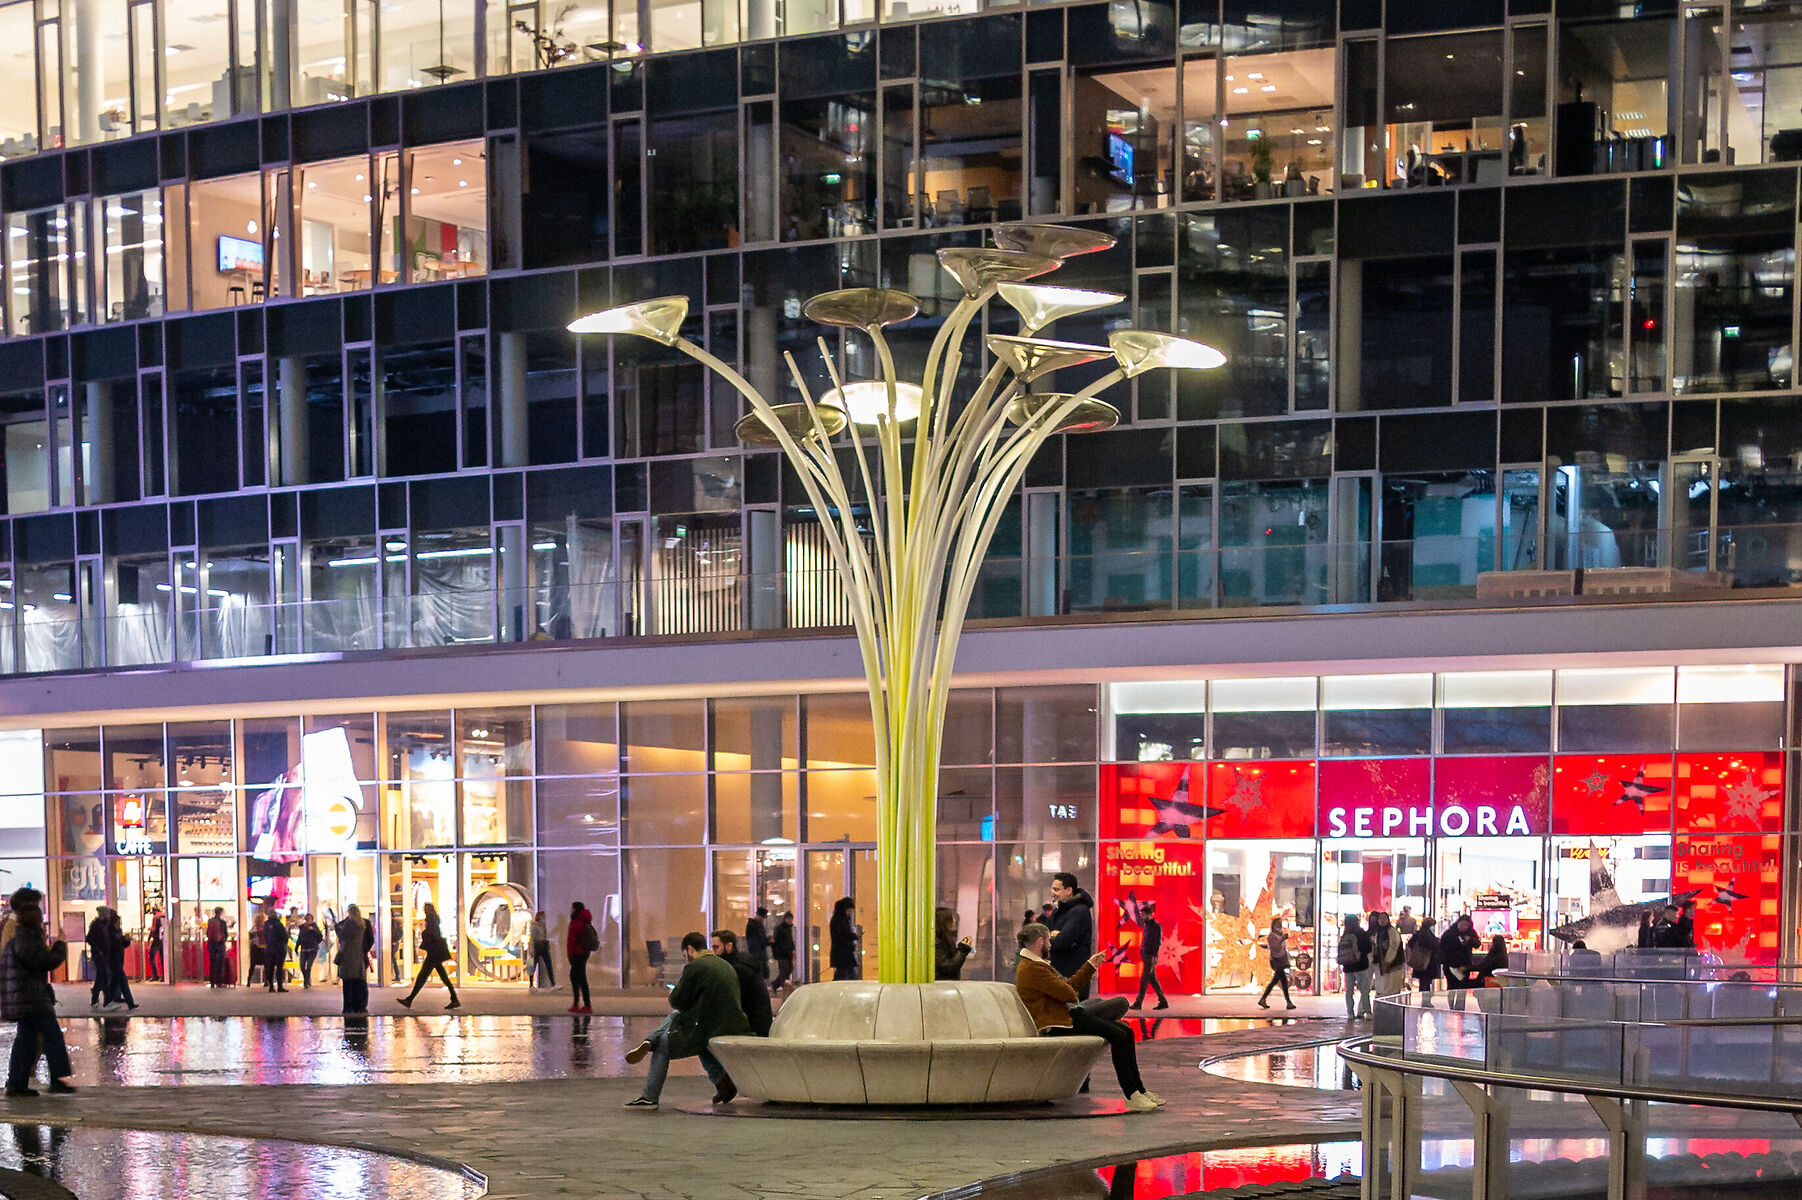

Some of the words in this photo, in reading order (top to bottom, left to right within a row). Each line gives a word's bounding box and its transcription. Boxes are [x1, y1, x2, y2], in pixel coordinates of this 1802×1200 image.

[1328, 805, 1530, 837] SEPHORA
[1106, 846, 1166, 863] Sharing
[1677, 842, 1743, 859] Sharing
[1106, 862, 1119, 876] is
[1123, 862, 1196, 876] beautiful.
[1676, 862, 1688, 873] is
